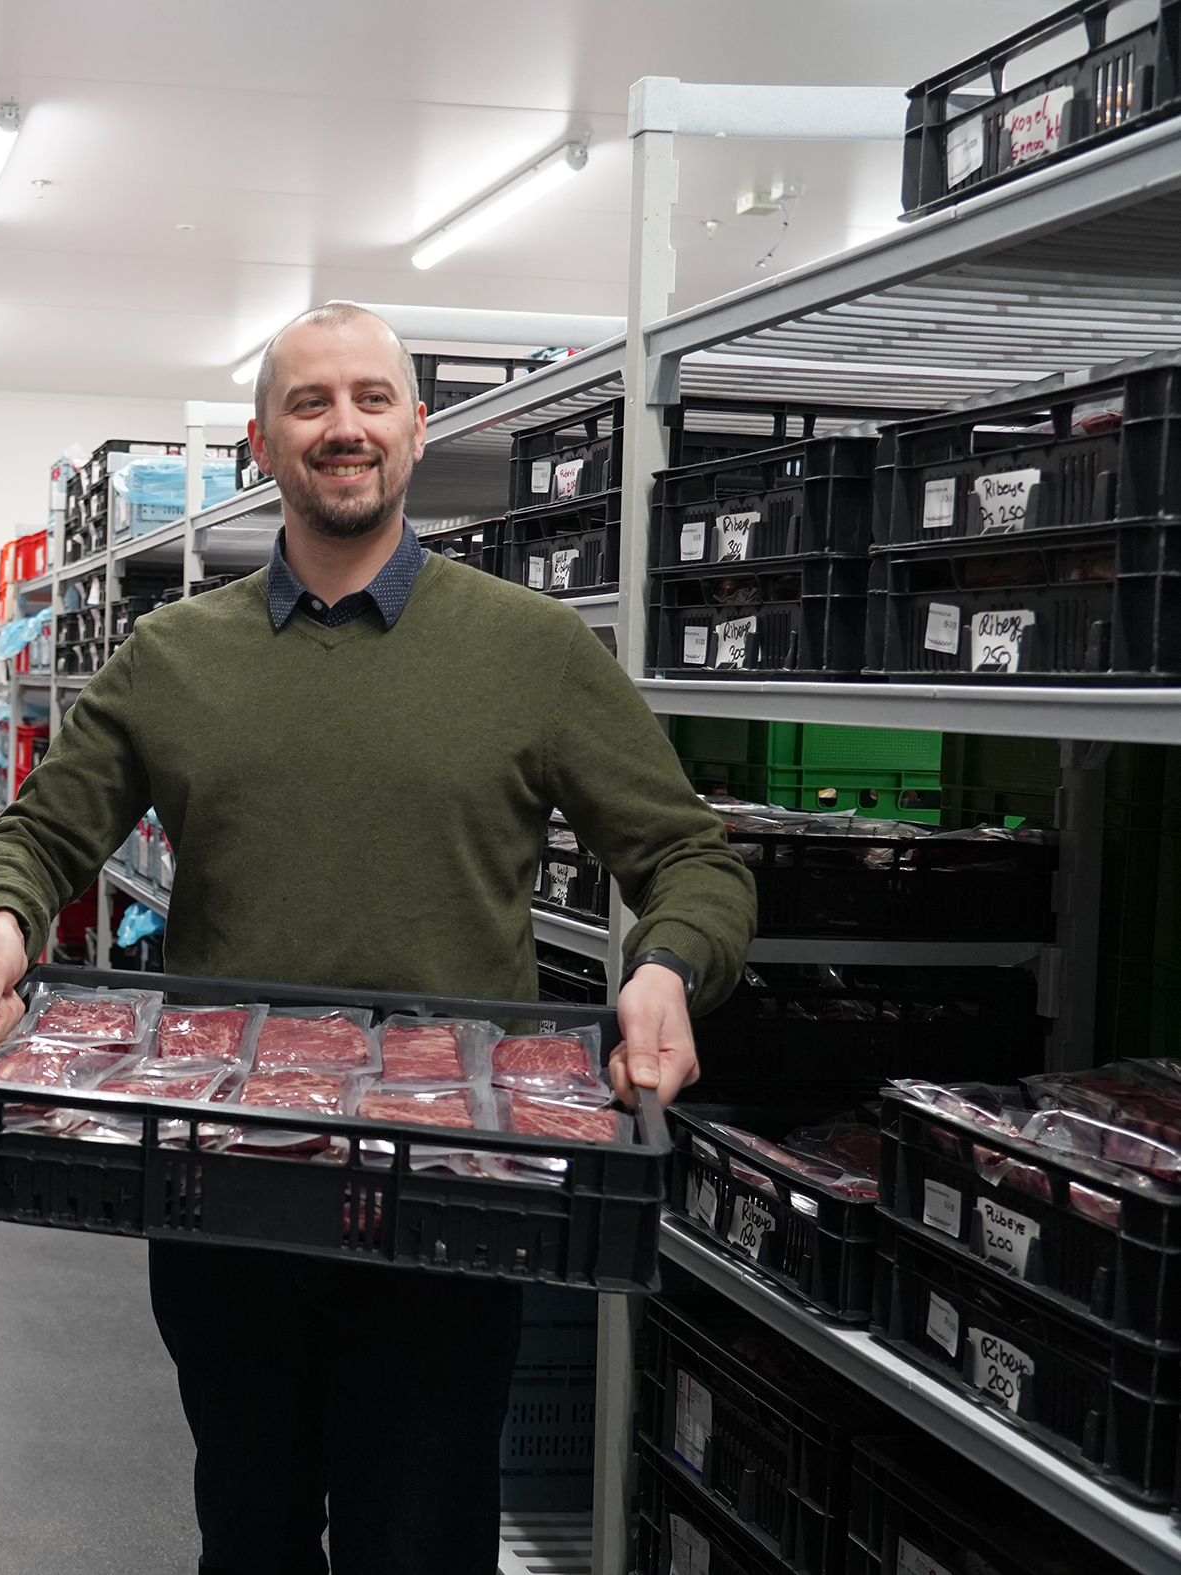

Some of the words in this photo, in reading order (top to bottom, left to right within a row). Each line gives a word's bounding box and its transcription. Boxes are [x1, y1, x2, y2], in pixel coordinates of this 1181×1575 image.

[982, 478, 1025, 500] Ribeye
[999, 505, 1026, 524] 250
[727, 539, 743, 555] 300
[728, 644, 746, 663] 300
[739, 1223, 757, 1248] 180
[986, 1229, 1013, 1253] 200
[987, 1364, 1014, 1399] 200
